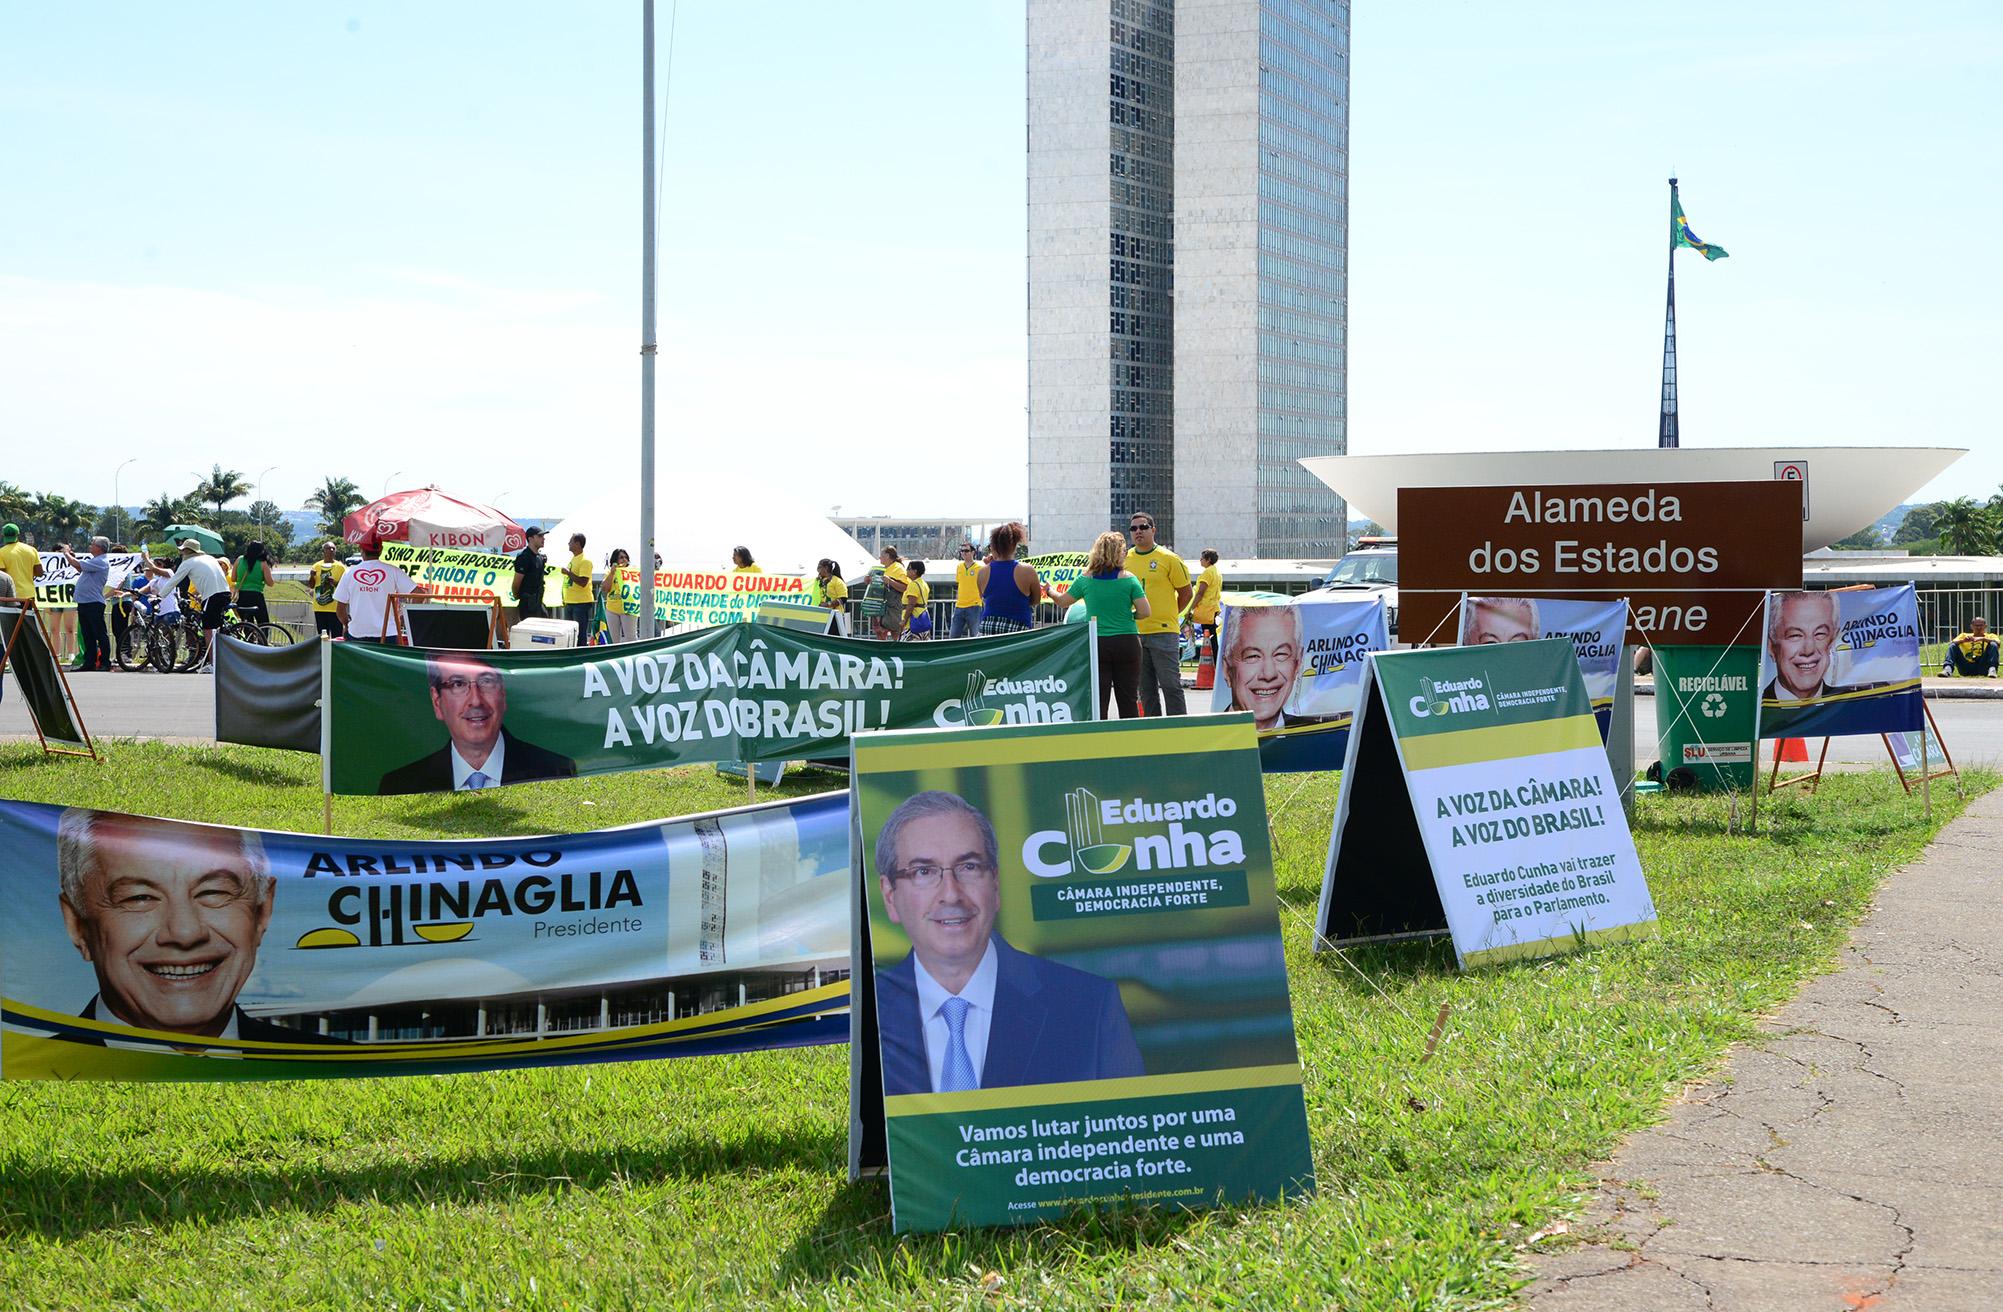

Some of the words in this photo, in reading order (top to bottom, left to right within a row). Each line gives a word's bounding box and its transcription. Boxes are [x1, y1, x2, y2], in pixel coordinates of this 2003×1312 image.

[1504, 489, 1682, 524] Alameda
[429, 533, 485, 546] KIBON
[1468, 541, 1541, 574] dos
[1554, 540, 1719, 574] Estados
[484, 571, 496, 586] O
[621, 569, 640, 583] DE
[654, 573, 727, 591] EDUARDO
[733, 576, 802, 592] CUNHA
[633, 586, 727, 609] SIDARIEDADE
[1307, 633, 1369, 653] ARLINDO
[1841, 625, 1915, 649] CHINAGLIA
[1311, 646, 1380, 675] CHINAG
[1575, 644, 1616, 658] AGLIA
[583, 662, 611, 698] A
[607, 653, 680, 695] VOZ
[682, 653, 736, 691] DA
[733, 639, 904, 690] CÂMARA!
[983, 675, 1068, 696] Eduardo
[1433, 677, 1483, 694] Eduardo
[1496, 692, 1521, 700] CÂMARA
[1521, 686, 1567, 698] INDEPENDENTE,
[1679, 674, 1748, 692] RECICLÁVEL
[1498, 697, 1536, 708] DEMOCRACIA
[1536, 695, 1556, 703] FORTE
[603, 707, 633, 749] A
[631, 701, 703, 745] VOZ
[703, 697, 745, 738] DO
[742, 699, 891, 738] BRASIL!
[1684, 747, 1705, 758] SLU
[1436, 798, 1452, 818] A
[1449, 792, 1489, 816] VOZ
[1487, 789, 1518, 811] DA
[1516, 775, 1603, 807] CÂMARA!
[1100, 793, 1237, 825] Eduardo
[1452, 826, 1467, 848] A
[1464, 820, 1504, 845] VOZ
[1503, 816, 1531, 839] DO
[1531, 805, 1606, 836] BRASIL!
[303, 851, 562, 878] ARLINDO
[1462, 868, 1516, 888] Eduardo
[1517, 862, 1559, 880] Cunha
[1559, 857, 1577, 873] vai
[1577, 853, 1616, 870] trazer
[1057, 886, 1113, 901] CÂMARA
[1116, 878, 1223, 897] INDEPENDENTE,
[1476, 894, 1486, 906] a
[1486, 879, 1560, 904] diversidade
[1561, 876, 1576, 891] do
[1576, 870, 1616, 888] Brasil
[328, 869, 645, 947] CHINAGLIA
[1075, 898, 1162, 913] DEMOCRACIA
[1165, 892, 1208, 906] FORTE
[1492, 906, 1523, 925] para
[1524, 904, 1533, 916] o
[1533, 892, 1611, 915] Parlamento.
[533, 918, 643, 939] Presidente
[959, 1124, 1028, 1143] Vamos
[1031, 1118, 1080, 1138] lutar
[1084, 1112, 1148, 1138] juntos
[1152, 1109, 1187, 1131] por
[1191, 1107, 1236, 1125] uma
[955, 1146, 1033, 1168] Câmara
[1038, 1133, 1180, 1162] independente
[1183, 1134, 1196, 1148] e
[1200, 1130, 1245, 1147] uma
[1015, 1161, 1132, 1187] democracia
[1135, 1158, 1192, 1178] forte.
[1007, 1201, 1037, 1210] Acesse
